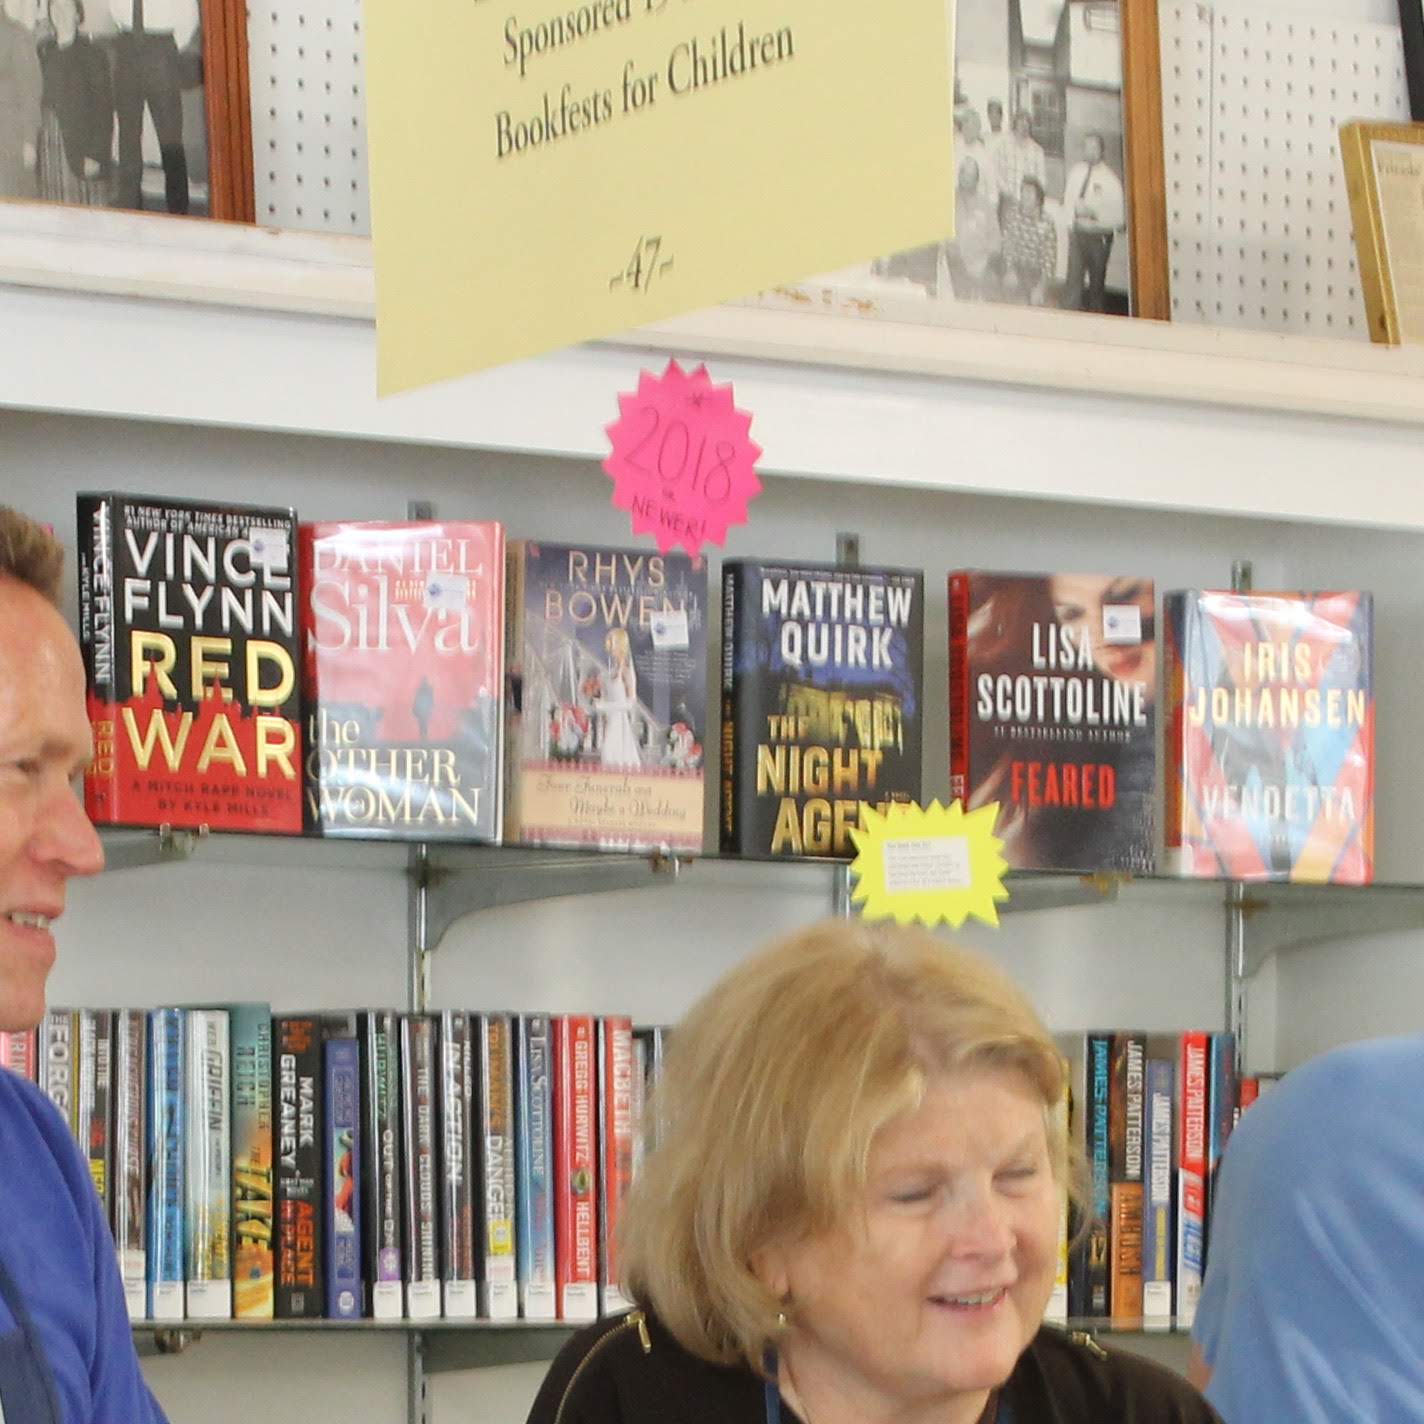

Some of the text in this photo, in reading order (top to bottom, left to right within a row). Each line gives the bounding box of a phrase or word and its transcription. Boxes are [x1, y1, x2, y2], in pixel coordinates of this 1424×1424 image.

[503, 0, 631, 79] Sponsored
[495, 20, 795, 160] Bookfests for Children
[624, 405, 736, 501] 2018
[312, 539, 483, 576] DANIEL
[569, 550, 665, 587] RHYS
[124, 577, 293, 638] FLYNN
[308, 574, 480, 656] Silva
[544, 590, 689, 626] BOWEN
[762, 578, 912, 627] MATTHEW
[131, 630, 296, 708] RED
[781, 621, 893, 670] QUIRK
[1032, 621, 1094, 672] LISA
[1242, 641, 1312, 683] IRIS
[309, 707, 360, 746] the
[767, 715, 810, 741] THE
[977, 672, 1147, 727] SCOTTOLINE
[1187, 686, 1366, 729] JOHANSEN
[122, 707, 297, 781] WAR
[306, 748, 461, 787] OTHER
[756, 743, 883, 797] NIGHT
[158, 799, 270, 816] BY KYLE MILLS
[307, 786, 483, 826] WOMAN
[1011, 761, 1117, 810] FEARED
[1202, 784, 1357, 824] VENDETTA
[235, 1046, 256, 1106] REICH
[257, 1022, 270, 1131] CHRISTOPHER
[530, 1036, 546, 1076] LISA
[613, 1029, 632, 1136] MACBETH
[208, 1049, 223, 1132] GRIFFIN
[279, 1054, 296, 1170] GREANEY
[299, 1076, 314, 1149] MARK
[1125, 1039, 1143, 1177] JAMES PATTERSON
[1186, 1043, 1206, 1159] JAMES PATTERSON
[530, 1076, 547, 1176] SCOTTOLINE
[1091, 1040, 1109, 1215] JAMES PATTERSON
[1152, 1092, 1171, 1202] JAMES PATTERSON
[575, 1040, 590, 1277] GREGG HURWITZ HELLBENT
[235, 1166, 272, 1251] TAKE
[280, 1224, 295, 1286] PLACE
[296, 1201, 315, 1286] AGENT
